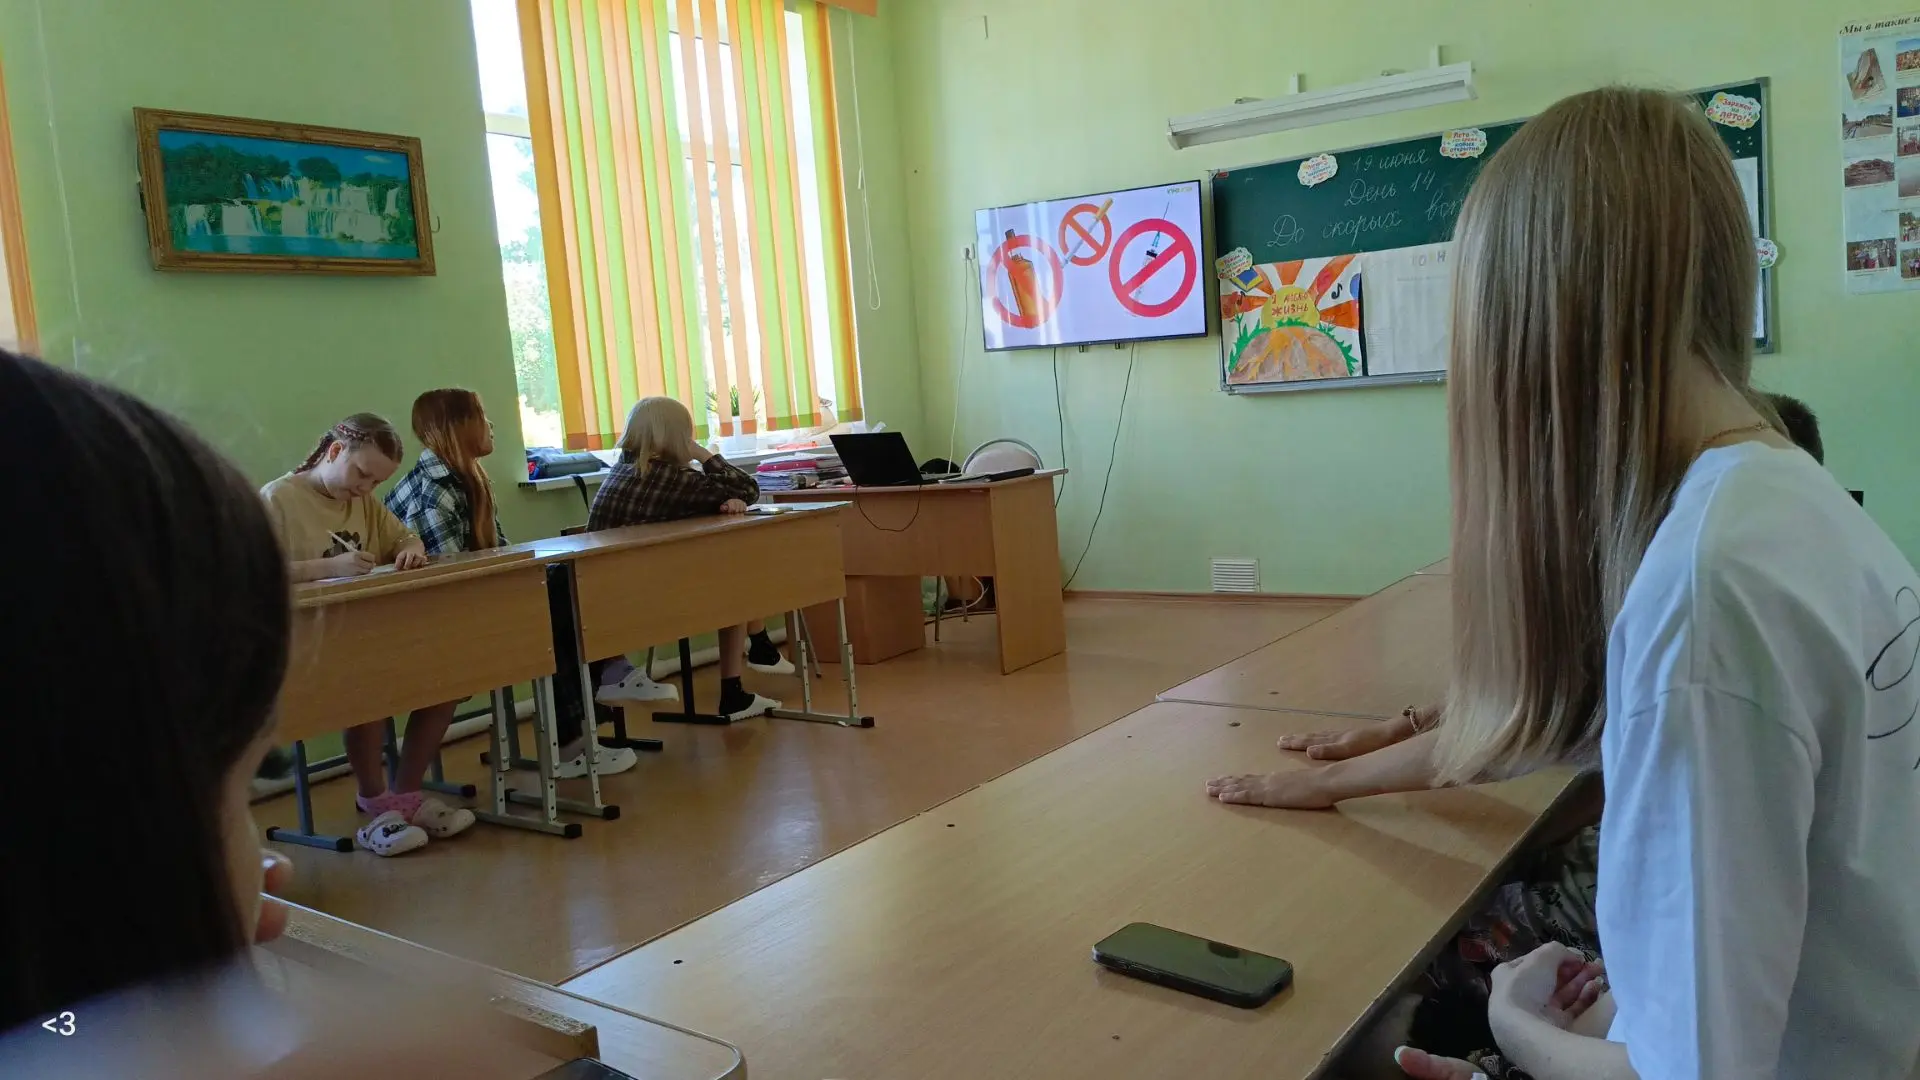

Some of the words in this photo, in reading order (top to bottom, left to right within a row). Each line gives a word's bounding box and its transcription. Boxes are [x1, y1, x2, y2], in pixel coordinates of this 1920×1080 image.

[1839, 24, 1862, 35] Мы
[1875, 17, 1911, 29] такие
[1353, 155, 1373, 173] 19
[1379, 148, 1429, 169] июня
[1344, 178, 1396, 207] День
[1410, 169, 1436, 192] 14
[1266, 214, 1305, 247] До
[1322, 210, 1402, 248] скорых
